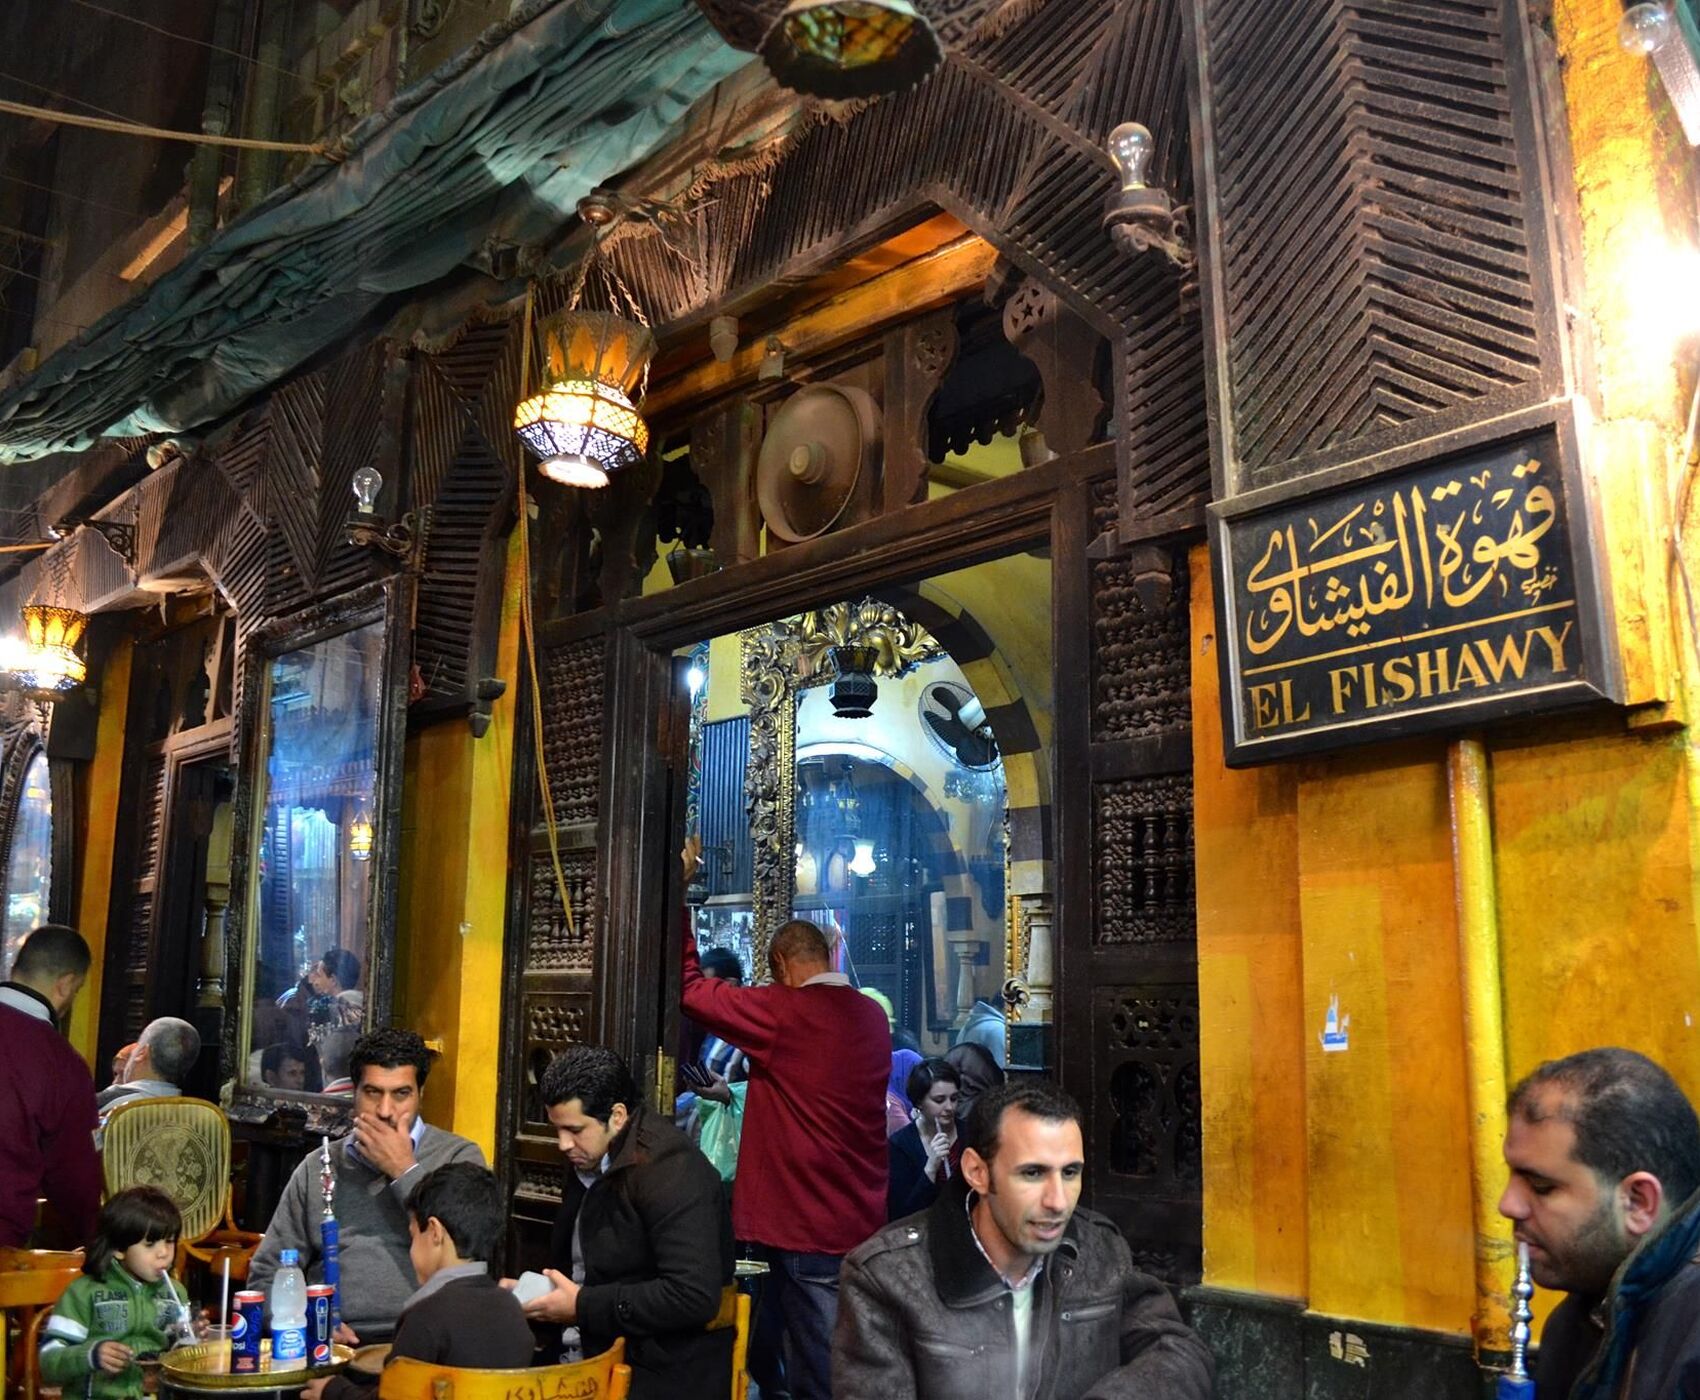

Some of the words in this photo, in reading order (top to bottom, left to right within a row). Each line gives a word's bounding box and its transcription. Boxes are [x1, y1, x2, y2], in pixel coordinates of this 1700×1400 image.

[1431, 458, 1556, 608] قهوة
[1248, 678, 1311, 730] EL
[1329, 621, 1574, 715] FISHAWY
